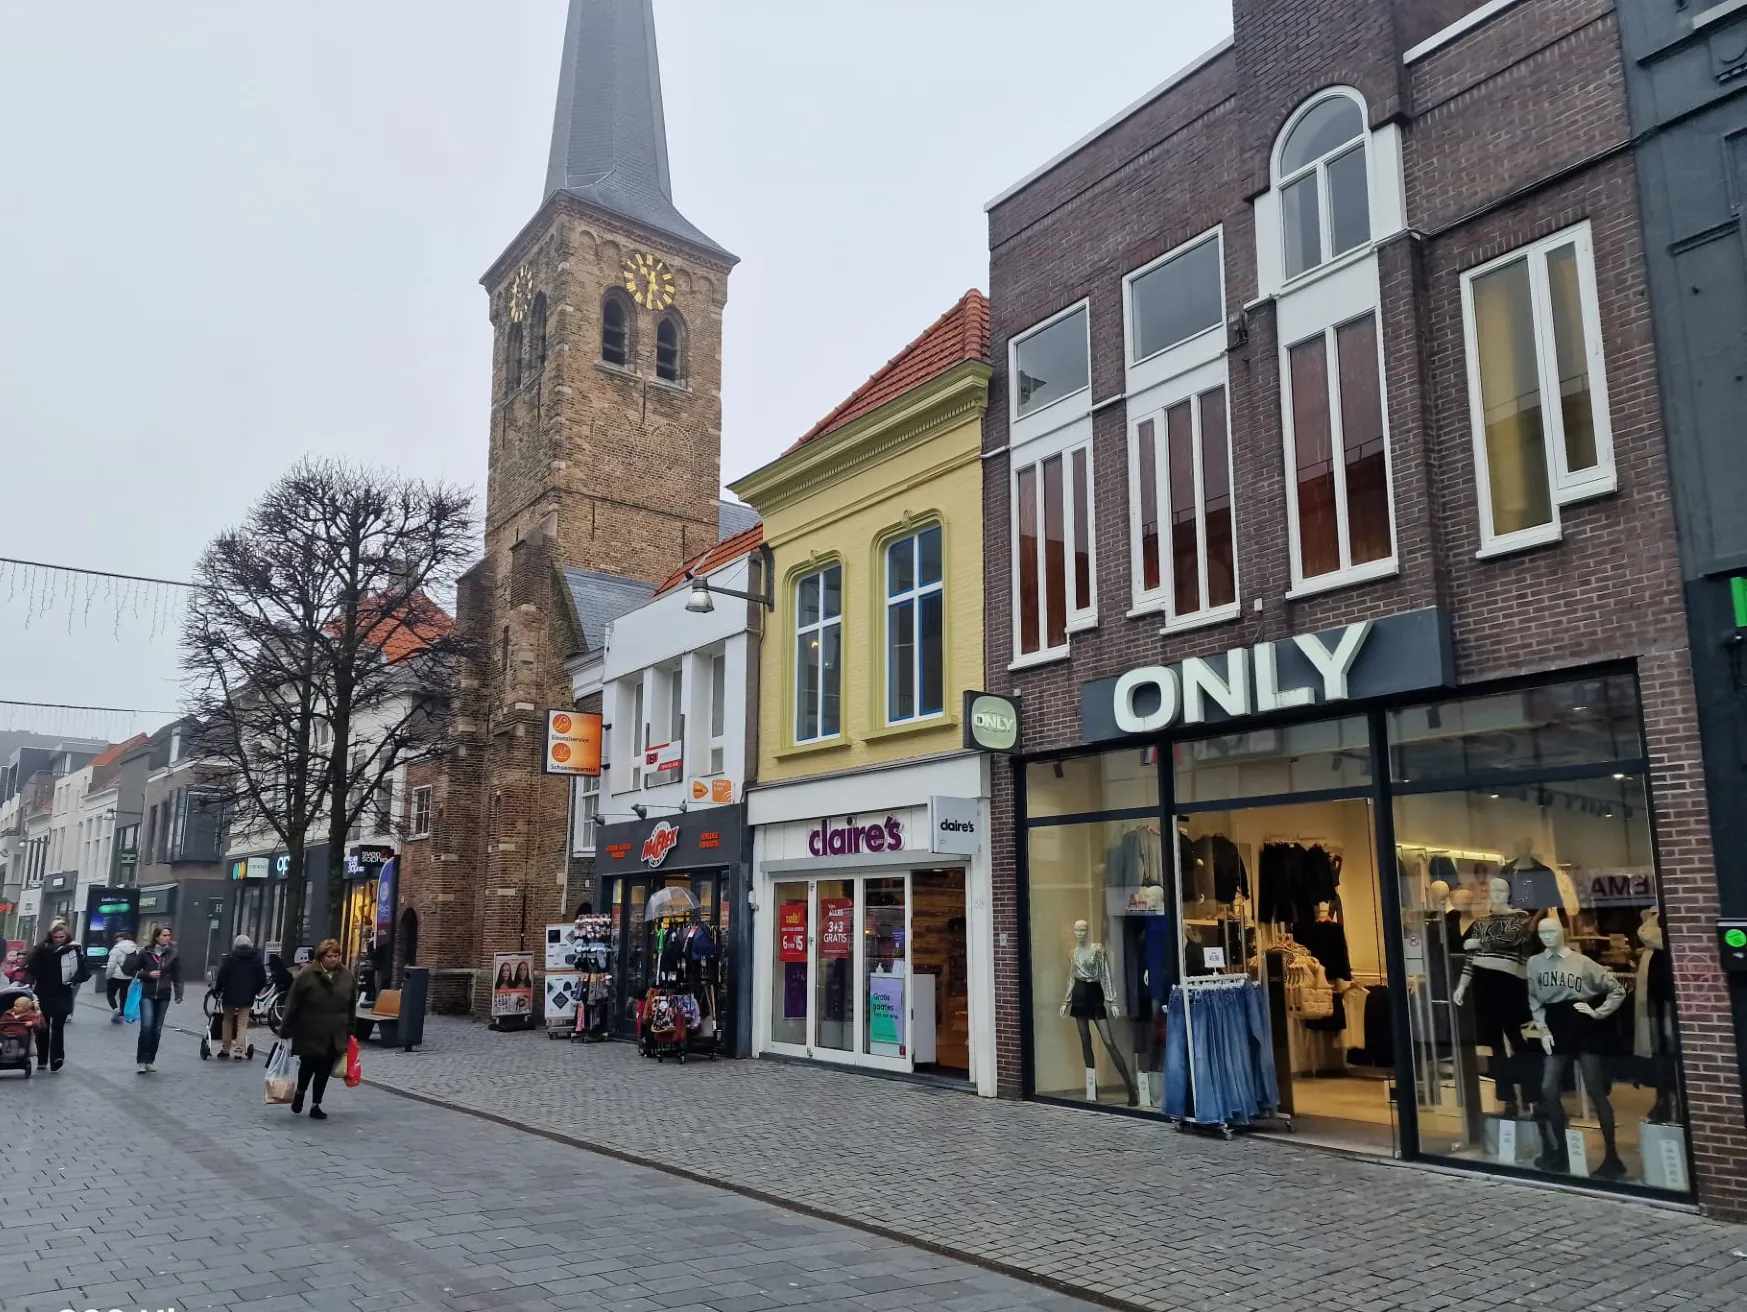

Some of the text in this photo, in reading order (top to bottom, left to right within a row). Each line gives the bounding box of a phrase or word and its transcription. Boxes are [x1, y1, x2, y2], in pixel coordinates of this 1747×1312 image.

[1113, 620, 1374, 733] ONLY
[973, 713, 1014, 732] ONLY
[940, 818, 975, 833] claire's
[808, 815, 904, 857] claire's
[828, 921, 844, 933] 3+3
[782, 935, 788, 949] 6
[823, 933, 848, 943] GRATIS
[873, 992, 890, 1001] Gratis
